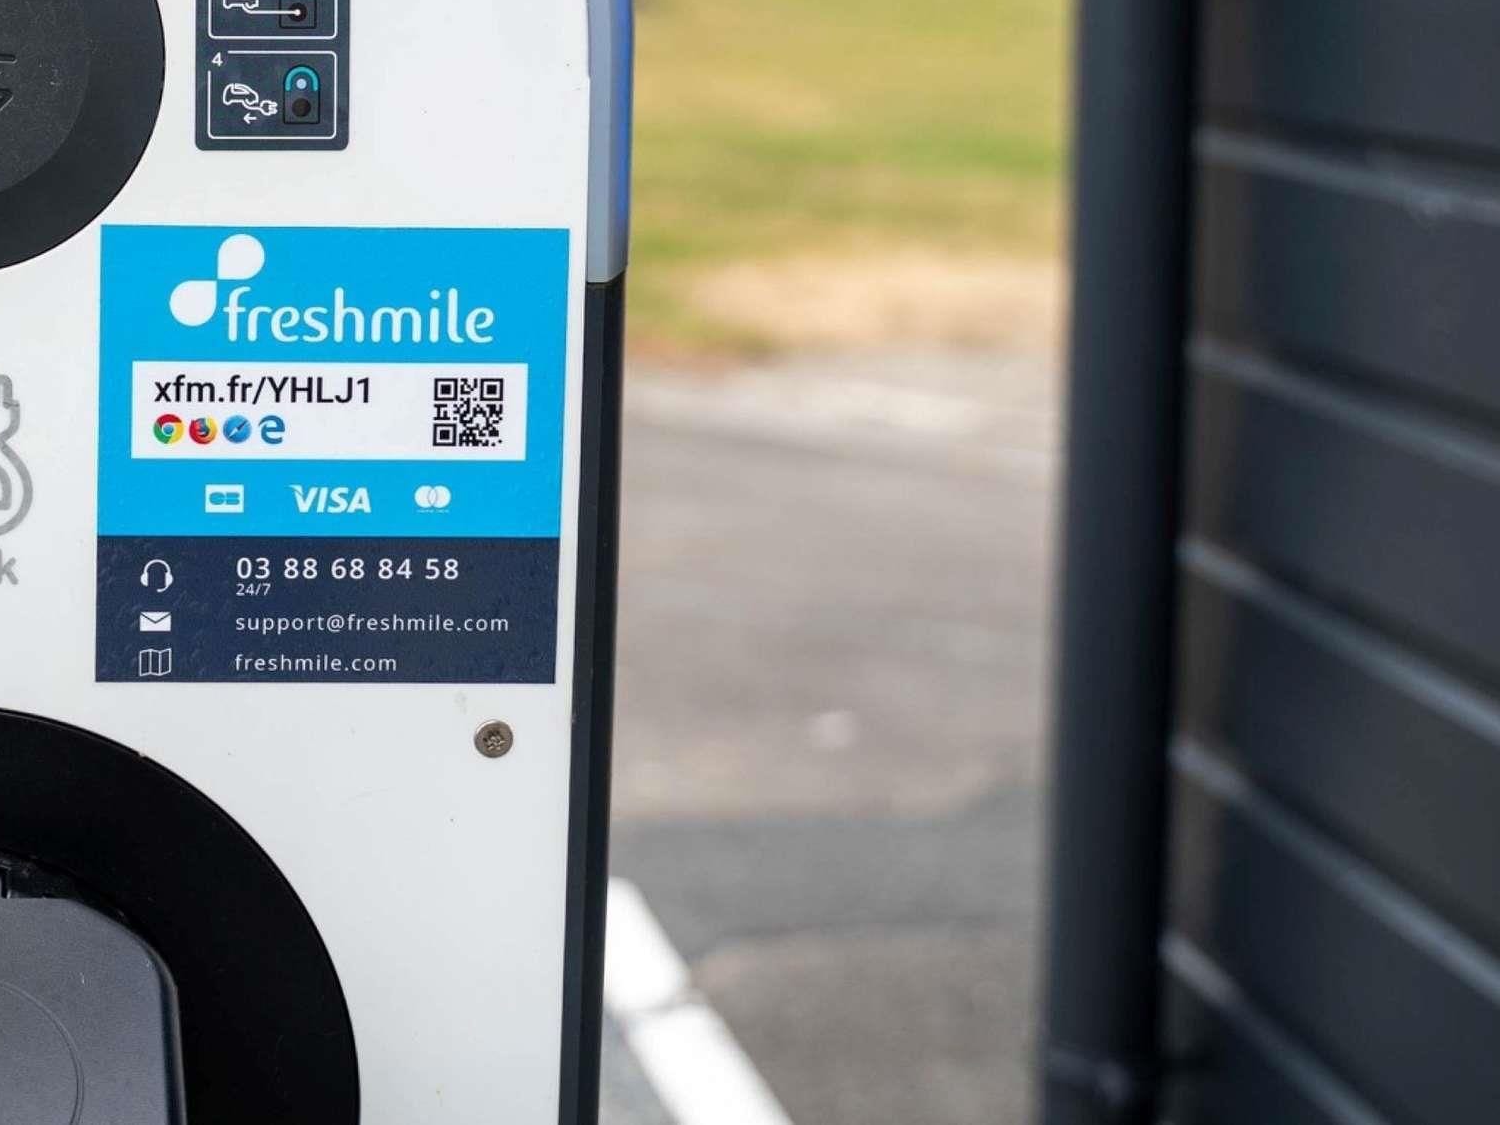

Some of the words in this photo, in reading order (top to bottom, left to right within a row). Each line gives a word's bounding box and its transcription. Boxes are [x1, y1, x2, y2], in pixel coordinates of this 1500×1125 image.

[212, 52, 222, 66] 4
[224, 287, 493, 342] freshmile
[155, 375, 368, 404] xfm.fr/YHLJ1
[291, 485, 371, 513] VISA
[237, 558, 269, 579] 03
[284, 558, 317, 579] 88
[332, 558, 364, 579] 68
[379, 559, 412, 579] 84
[426, 559, 458, 579] 58
[236, 583, 270, 596] 24/7
[236, 614, 508, 634] support@freshmile.com
[235, 654, 396, 671] freshmile.com
